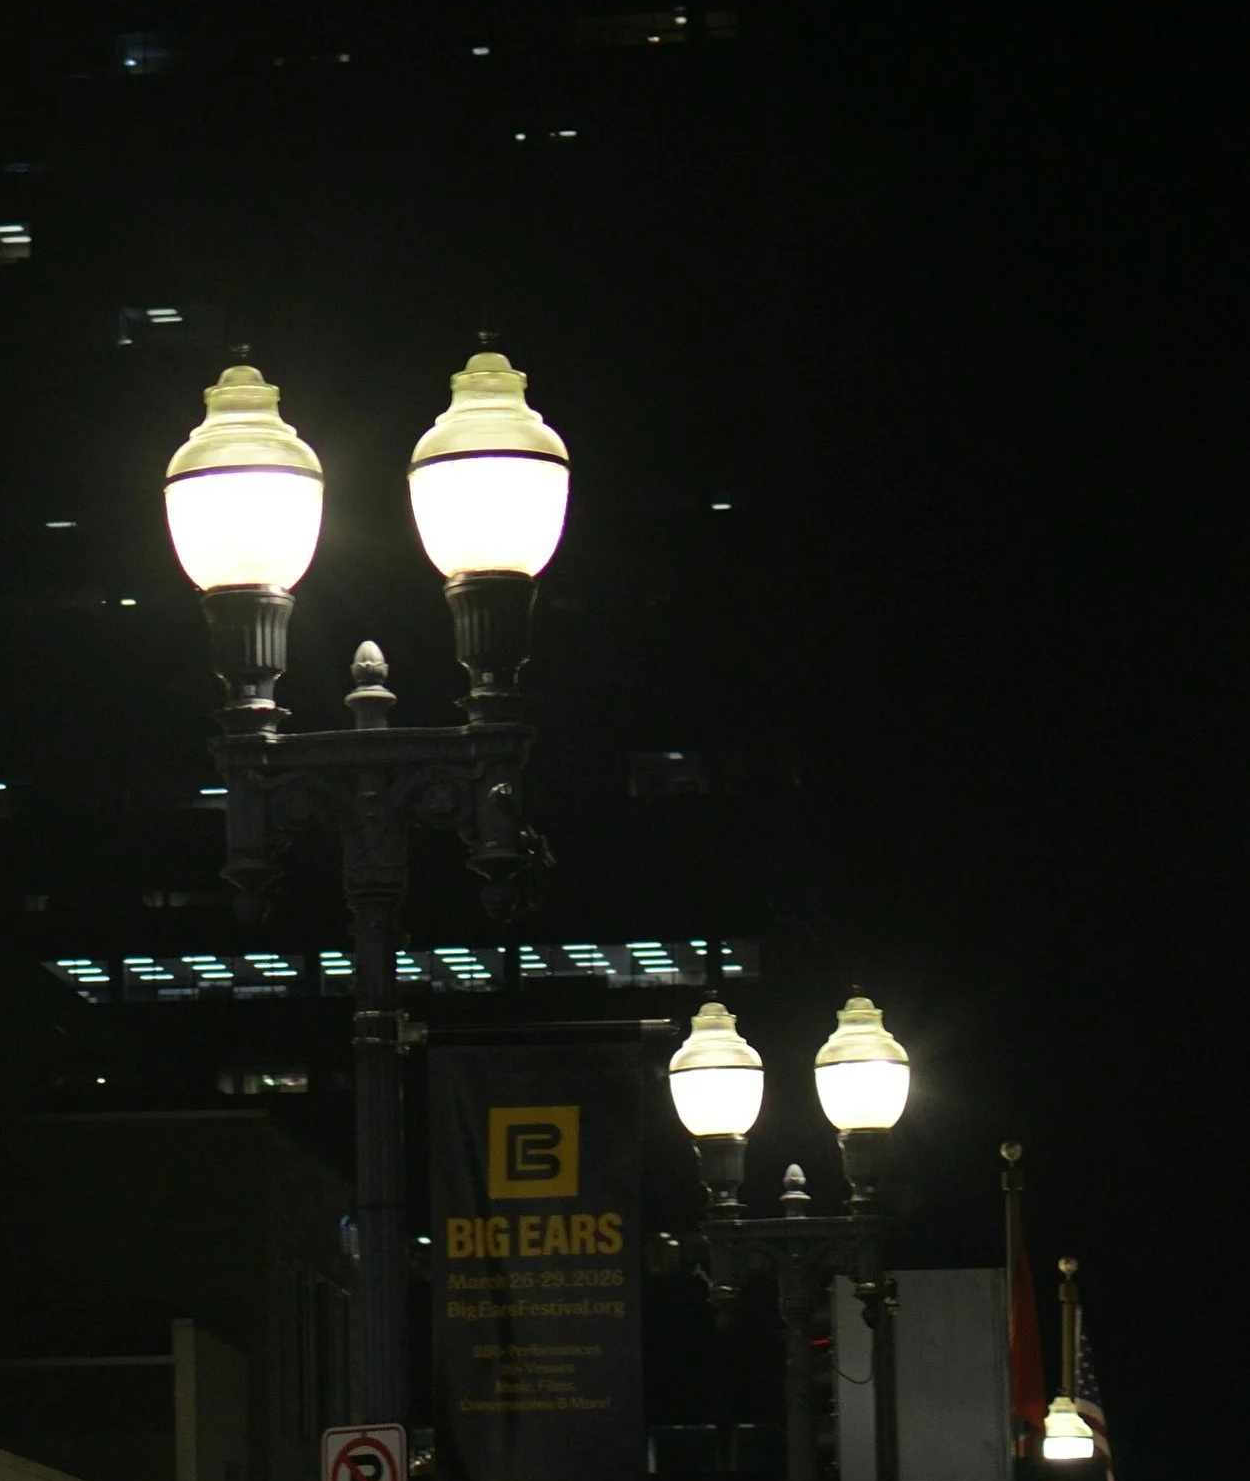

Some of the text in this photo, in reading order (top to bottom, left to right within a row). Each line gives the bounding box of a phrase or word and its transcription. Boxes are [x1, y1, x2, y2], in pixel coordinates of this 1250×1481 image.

[446, 1211, 624, 1259] BIG EARS
[447, 1272, 507, 1291] March
[572, 1269, 625, 1286] 2026
